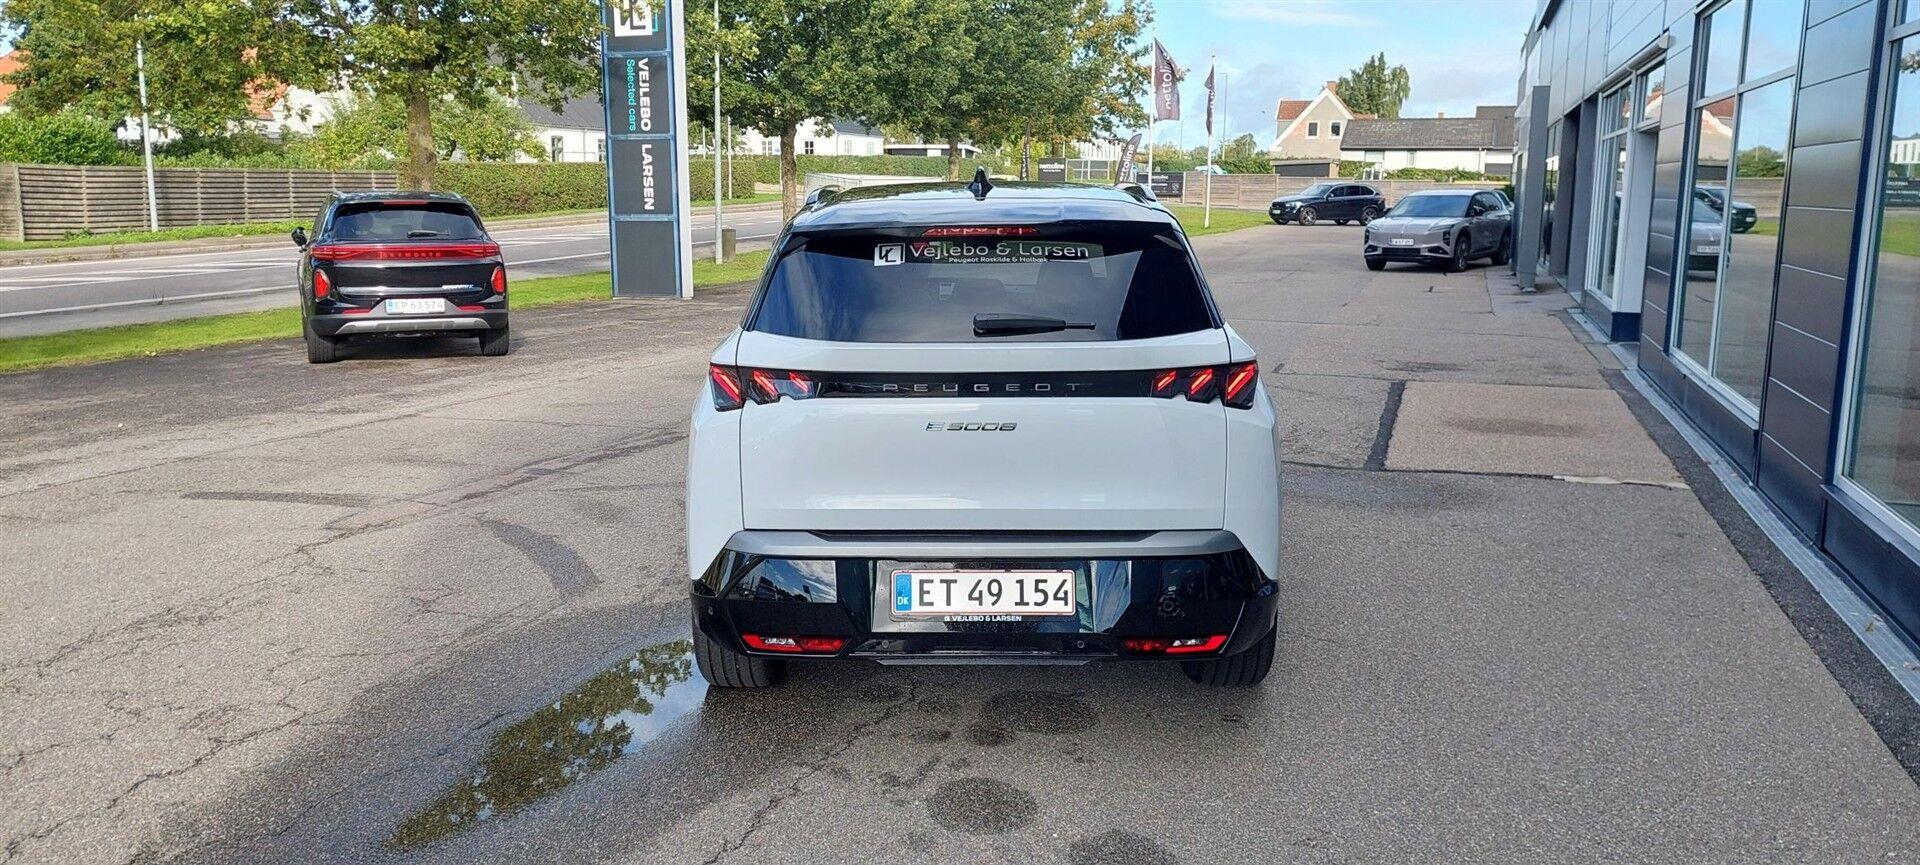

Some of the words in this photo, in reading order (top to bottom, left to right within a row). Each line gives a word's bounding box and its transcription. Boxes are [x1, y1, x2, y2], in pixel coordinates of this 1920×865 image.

[626, 58, 636, 106] Selected
[638, 57, 652, 132] VEJLEBO
[628, 108, 637, 131] cars
[641, 144, 655, 210] LARSEN
[909, 242, 989, 260] Vejlebo
[996, 242, 1011, 256] &
[1019, 242, 1089, 257] Larsen
[883, 383, 1081, 392] PEUGEOT
[925, 421, 945, 432] E
[947, 421, 1018, 432] 5008
[897, 597, 910, 606] DK
[918, 579, 958, 607] ET
[967, 578, 1003, 607] 49
[1014, 578, 1069, 607] 154
